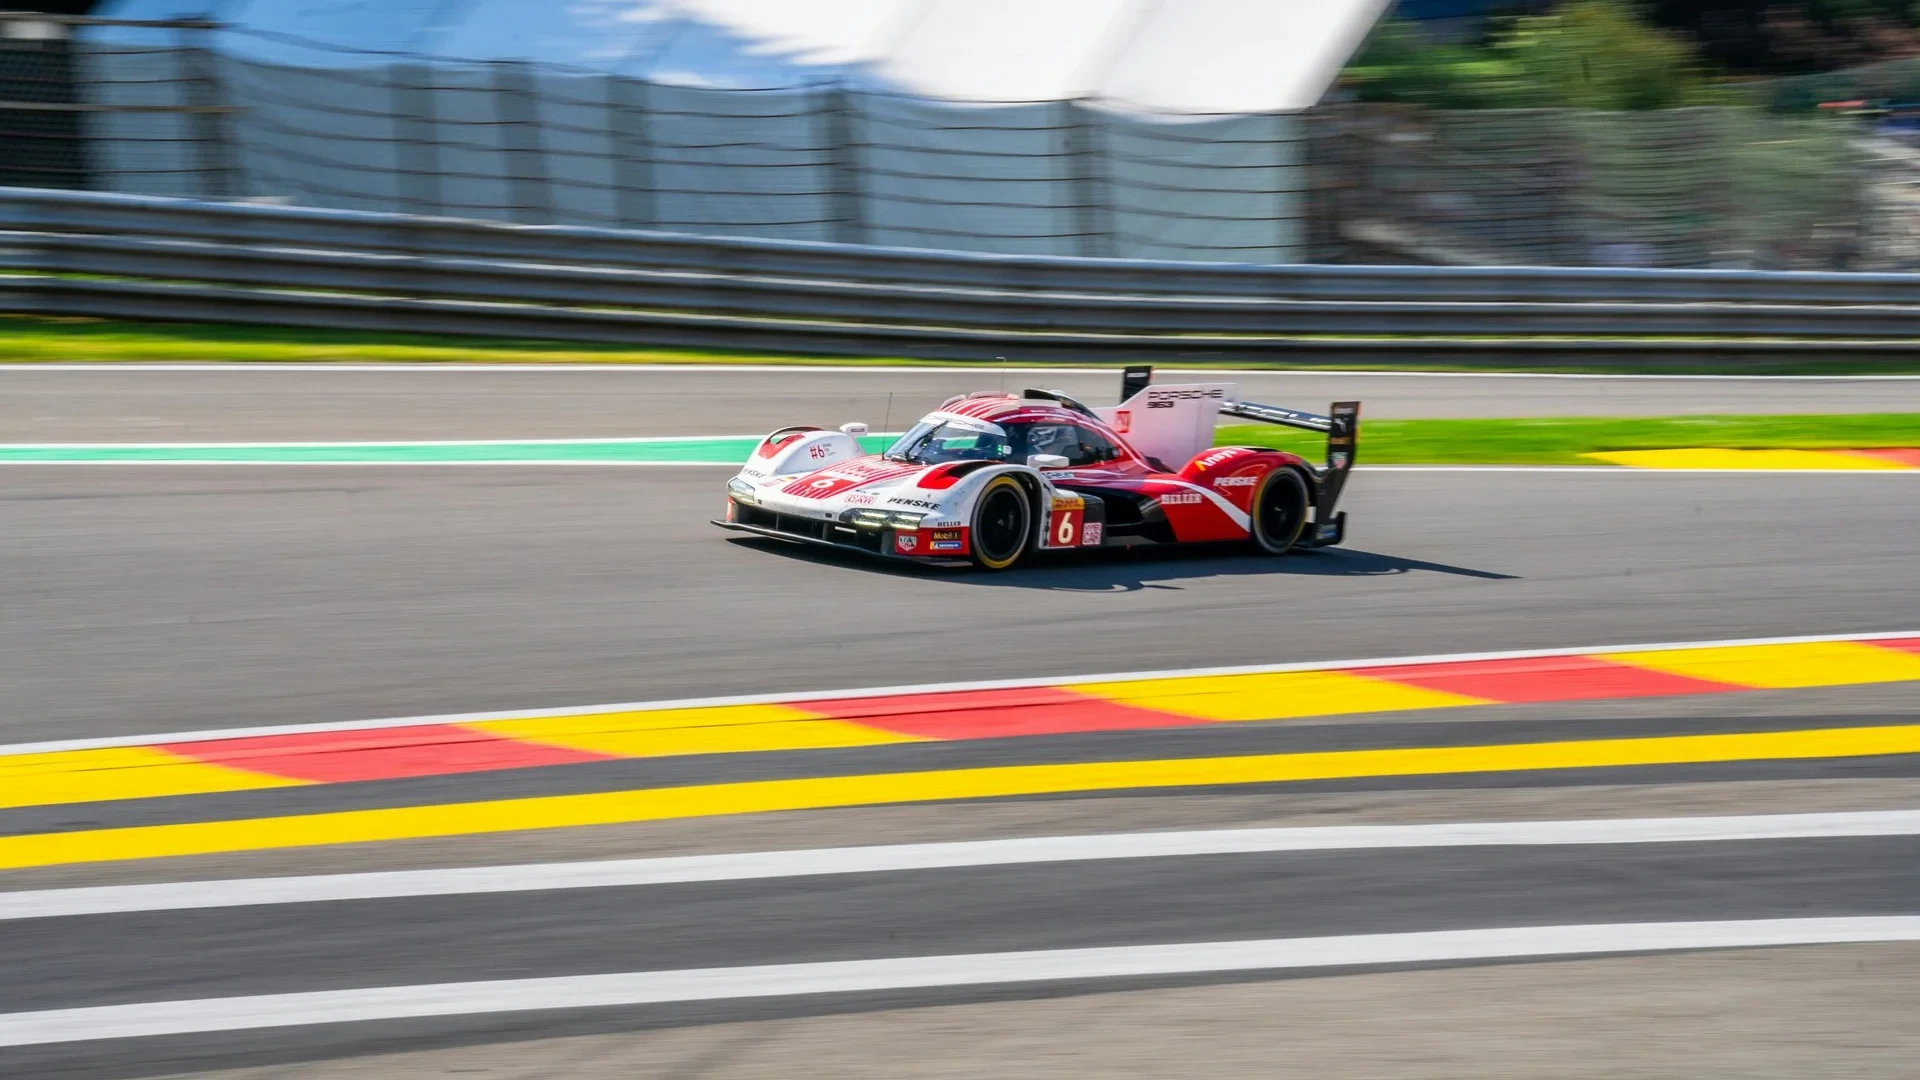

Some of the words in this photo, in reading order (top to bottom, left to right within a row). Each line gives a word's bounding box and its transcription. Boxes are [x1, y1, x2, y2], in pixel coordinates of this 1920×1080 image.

[1147, 389, 1224, 400] PORSCHE
[809, 445, 825, 459] #6
[887, 497, 941, 511] PENSKE
[1058, 511, 1074, 544] 6
